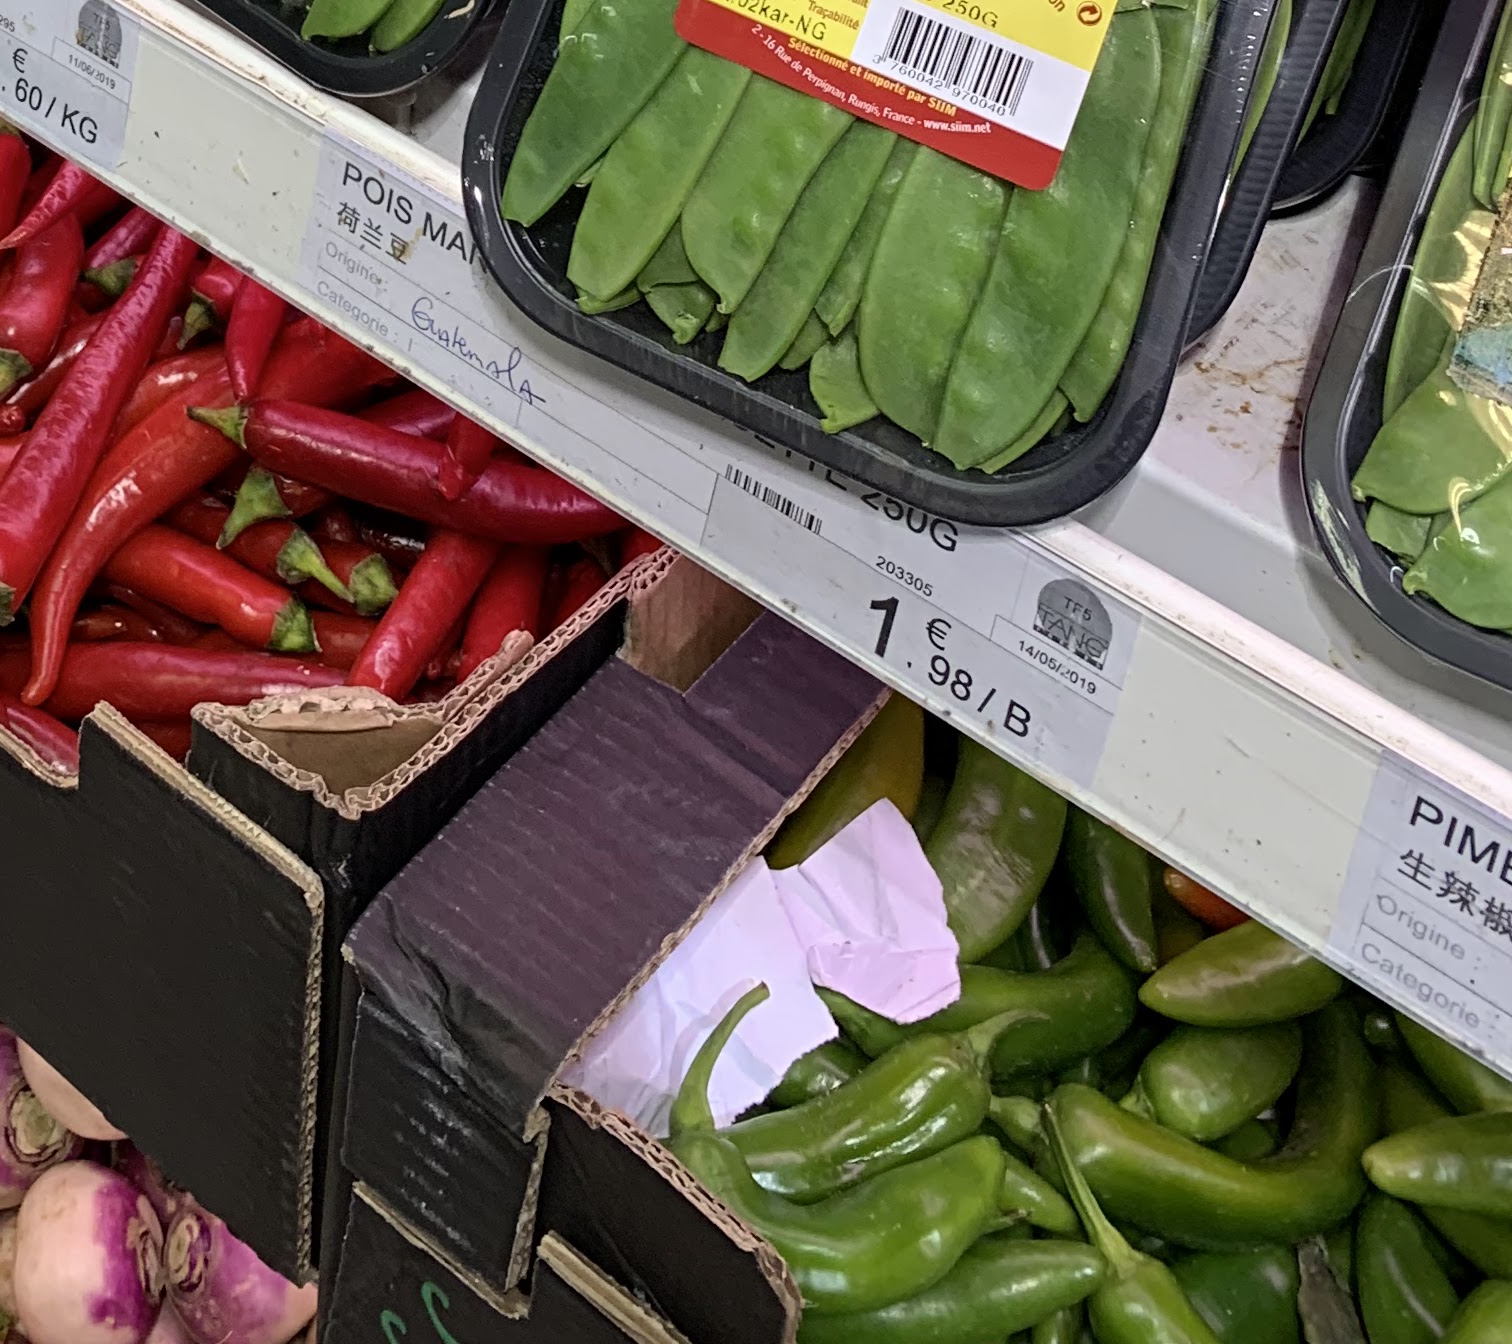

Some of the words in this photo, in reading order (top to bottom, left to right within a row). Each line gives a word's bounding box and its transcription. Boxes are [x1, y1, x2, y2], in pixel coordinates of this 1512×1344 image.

[774, 45, 792, 64] Rue
[790, 59, 803, 73] de
[801, 66, 848, 104] Perpignan,
[847, 92, 881, 118] Rungis,
[882, 107, 915, 125] France
[923, 118, 991, 133] www.siim.net
[787, 37, 848, 72] Sélectionné
[849, 63, 863, 77] et
[863, 70, 906, 98] importé
[906, 88, 927, 105] par
[927, 97, 957, 117] SIIM
[889, 61, 943, 91] 760042
[952, 87, 1006, 116] 970040
[342, 160, 413, 225] POIS
[336, 202, 411, 265] 荷兰豆
[315, 280, 389, 336] Categorie
[874, 555, 934, 597] 203305
[1062, 594, 1093, 623] TF5
[1017, 638, 1098, 696] 14/05/2019
[1376, 894, 1466, 962] Origine
[1361, 942, 1480, 1030] Categorie
